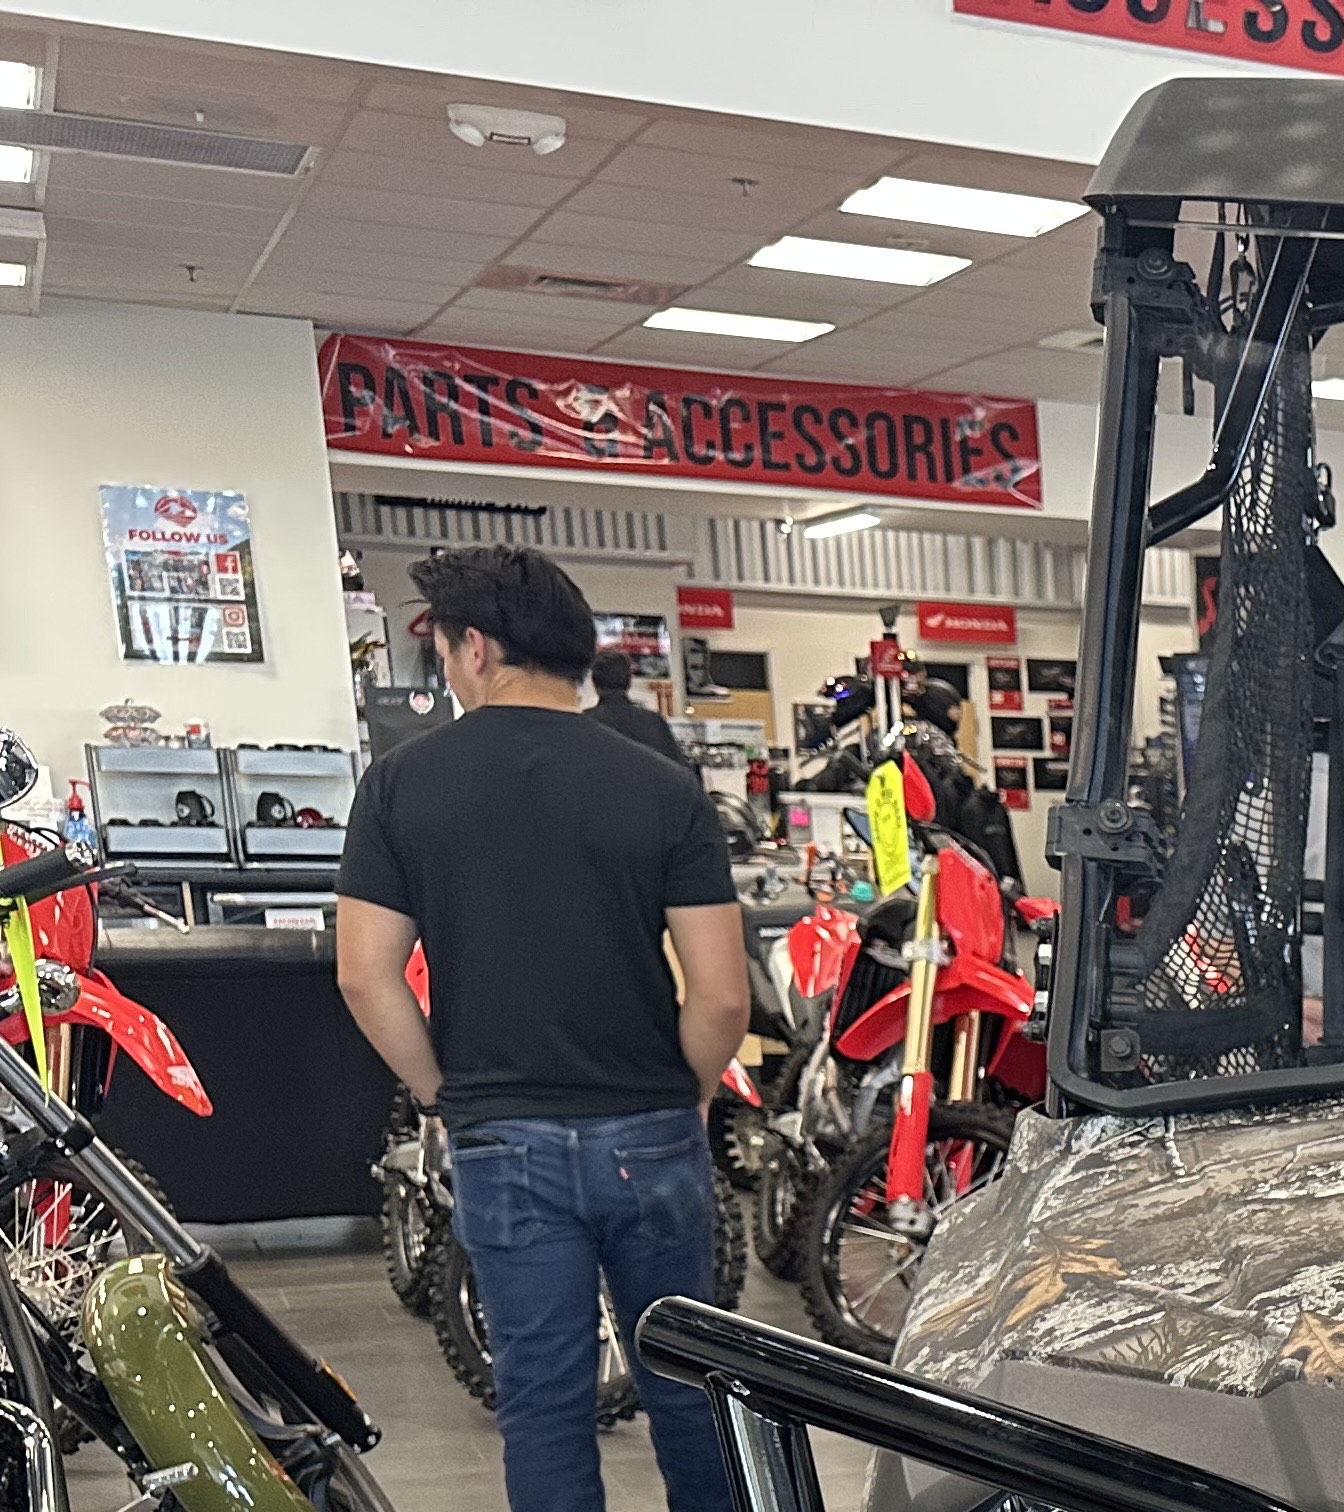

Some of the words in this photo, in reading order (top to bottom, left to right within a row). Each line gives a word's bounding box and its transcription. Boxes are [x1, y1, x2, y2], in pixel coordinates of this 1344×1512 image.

[337, 361, 544, 452] PARTS
[641, 389, 1021, 489] ACCESSORIES
[127, 528, 201, 545] FOLLOW
[205, 532, 229, 545] US
